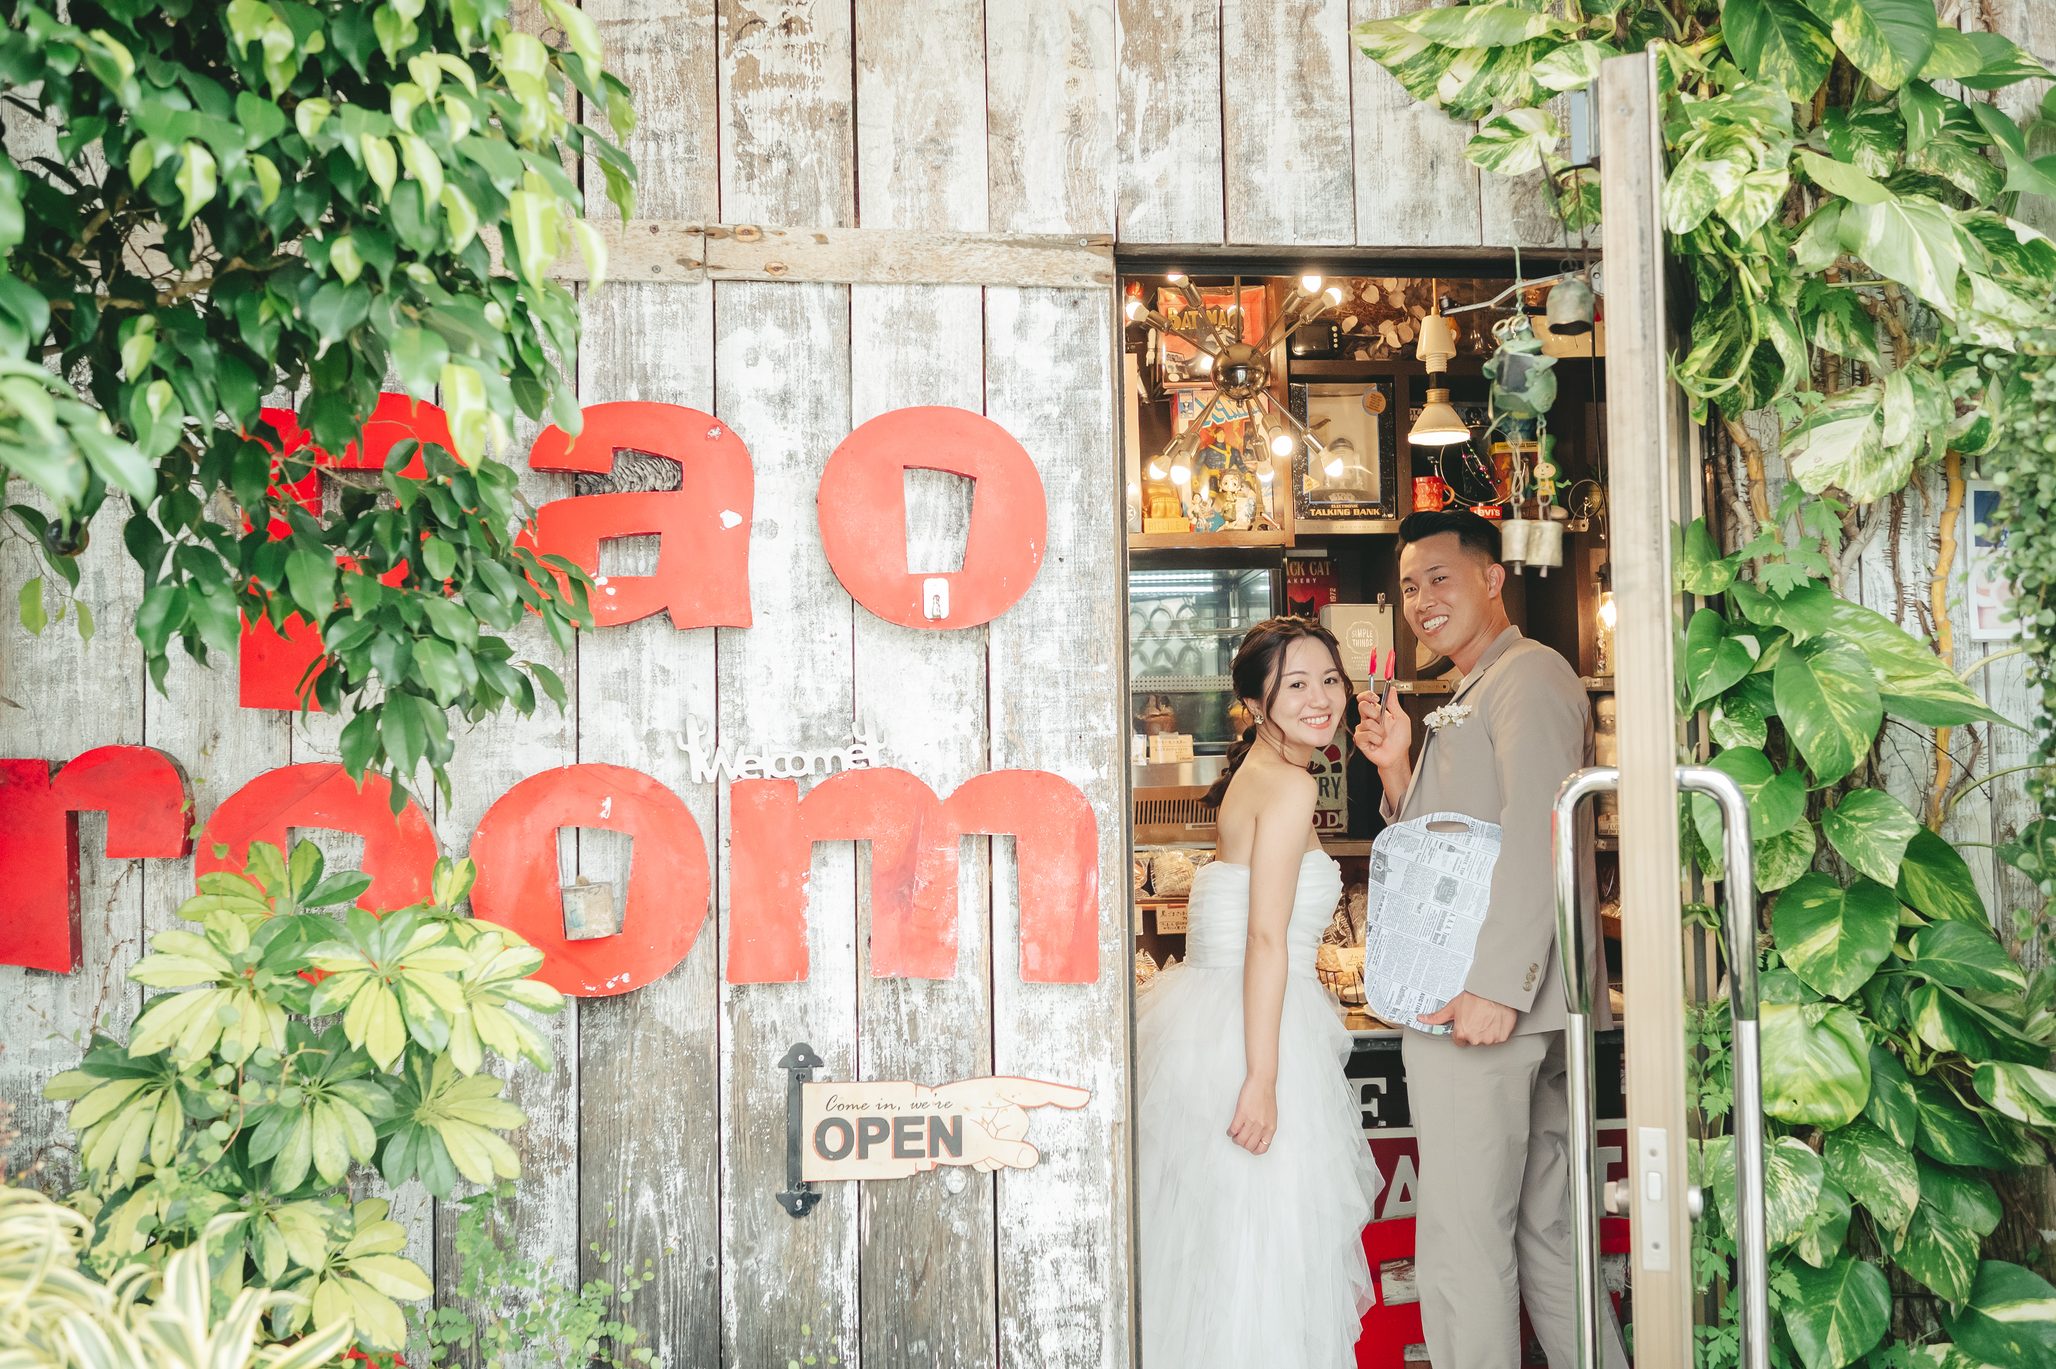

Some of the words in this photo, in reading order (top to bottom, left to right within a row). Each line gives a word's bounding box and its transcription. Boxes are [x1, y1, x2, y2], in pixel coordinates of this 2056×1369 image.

[1167, 307, 1240, 331] BATMA
[1310, 508, 1351, 516] TALKING
[1353, 508, 1381, 516] BANK
[1309, 561, 1331, 576] CAT
[825, 1094, 870, 1112] Come
[910, 1092, 953, 1109] we're
[812, 1114, 963, 1161] OPEN
